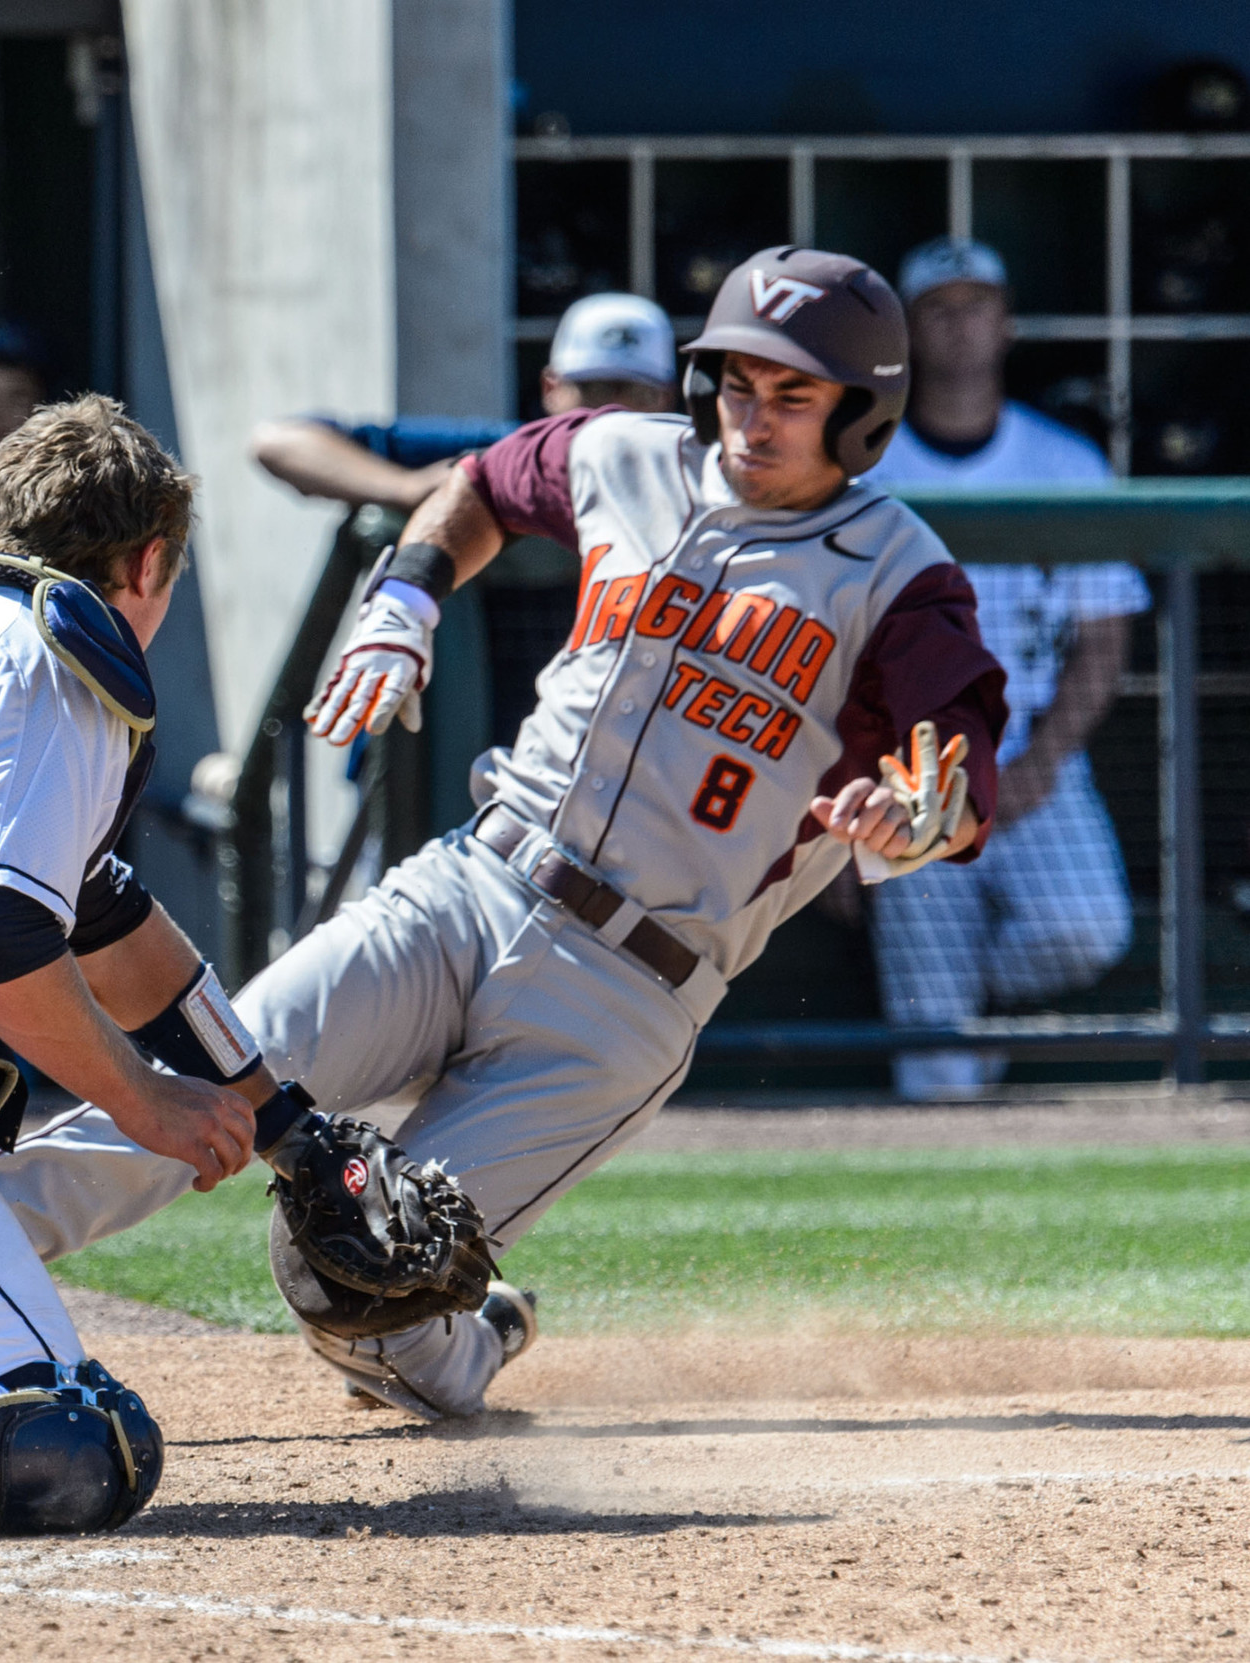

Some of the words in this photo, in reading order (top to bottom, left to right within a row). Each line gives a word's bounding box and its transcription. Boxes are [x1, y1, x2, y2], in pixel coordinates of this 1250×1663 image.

[749, 267, 829, 325] VT
[661, 661, 803, 761] TECH
[688, 752, 756, 834] 8
